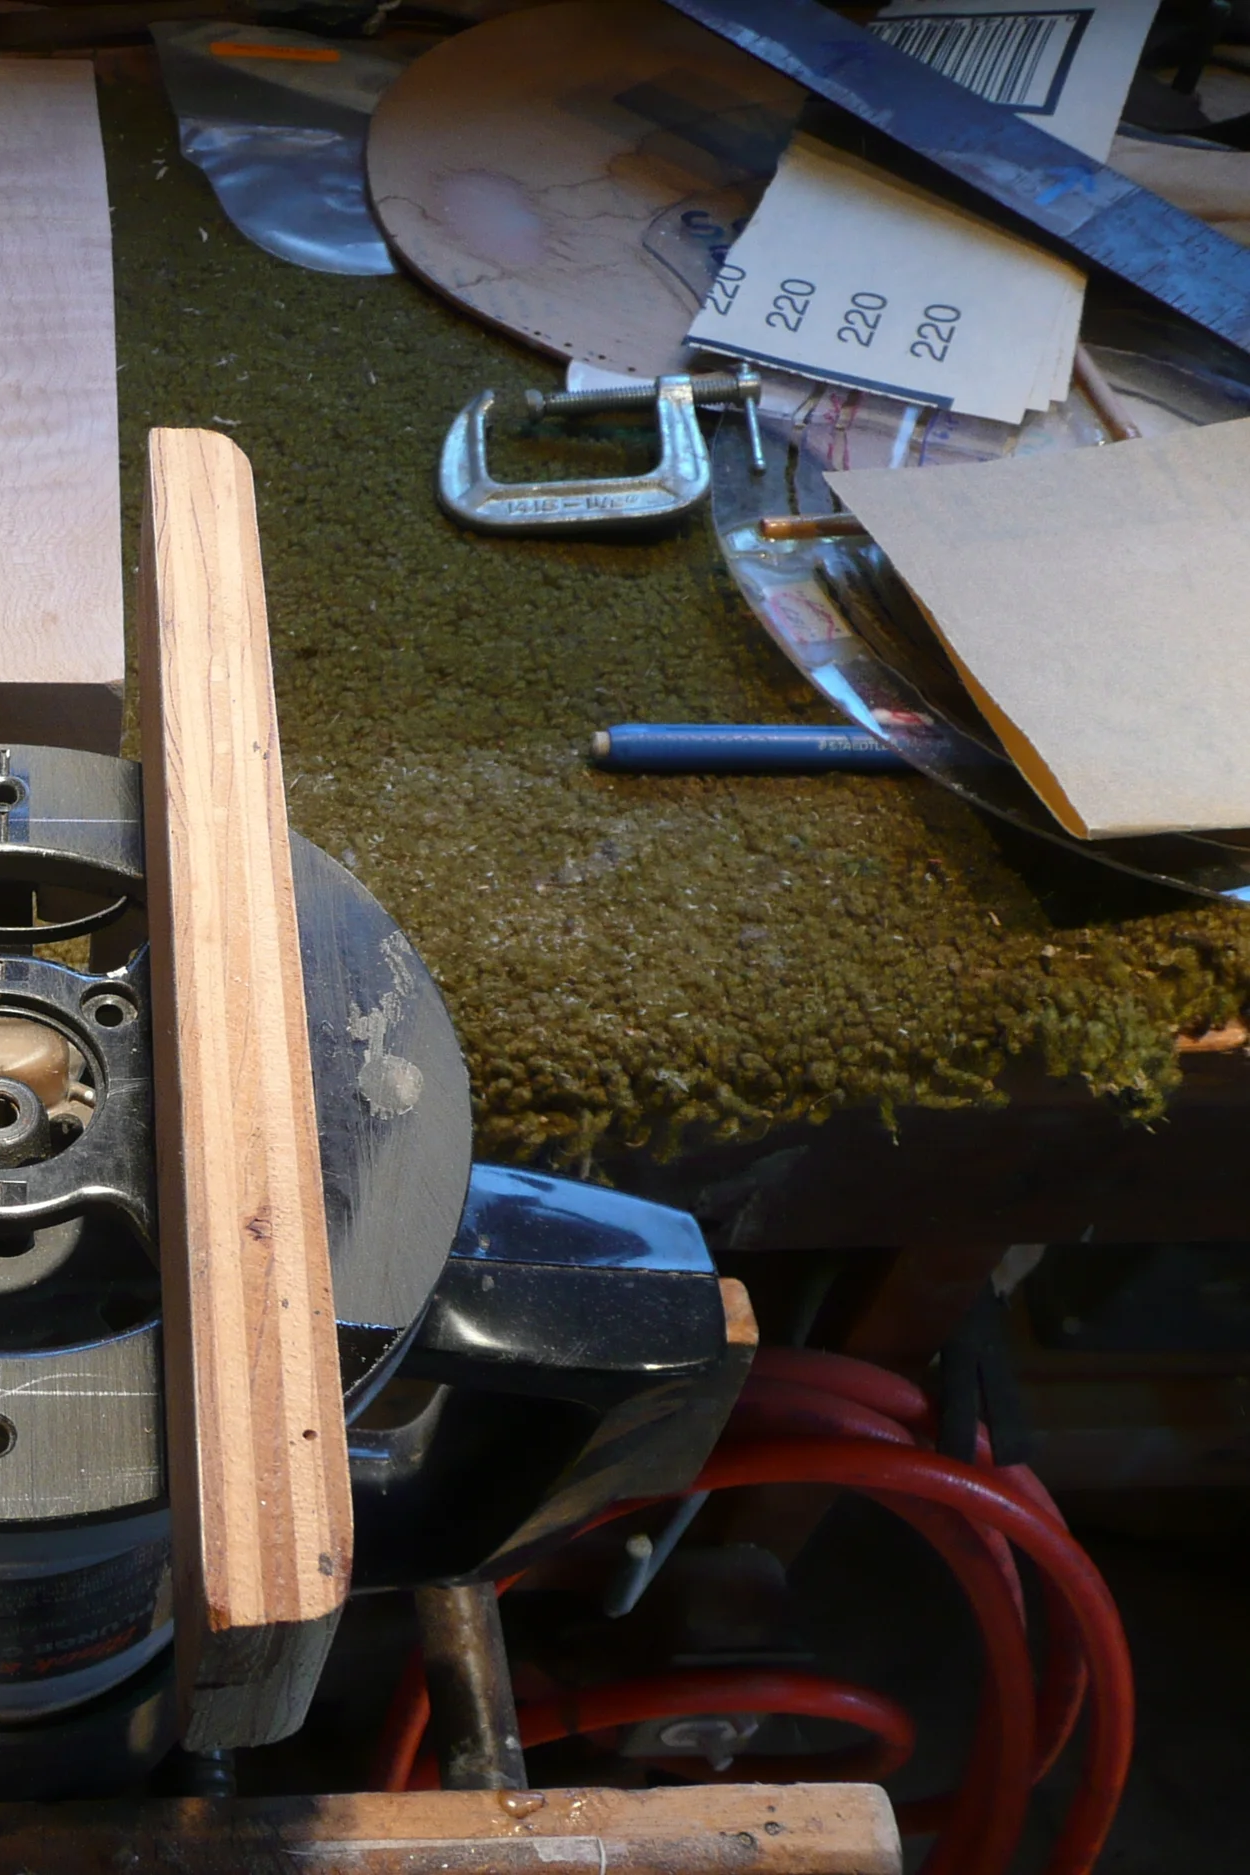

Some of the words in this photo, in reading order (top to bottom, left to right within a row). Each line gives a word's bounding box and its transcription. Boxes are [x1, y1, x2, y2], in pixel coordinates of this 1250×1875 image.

[765, 278, 816, 333] 220
[837, 292, 888, 348] 220
[909, 304, 962, 363] 220
